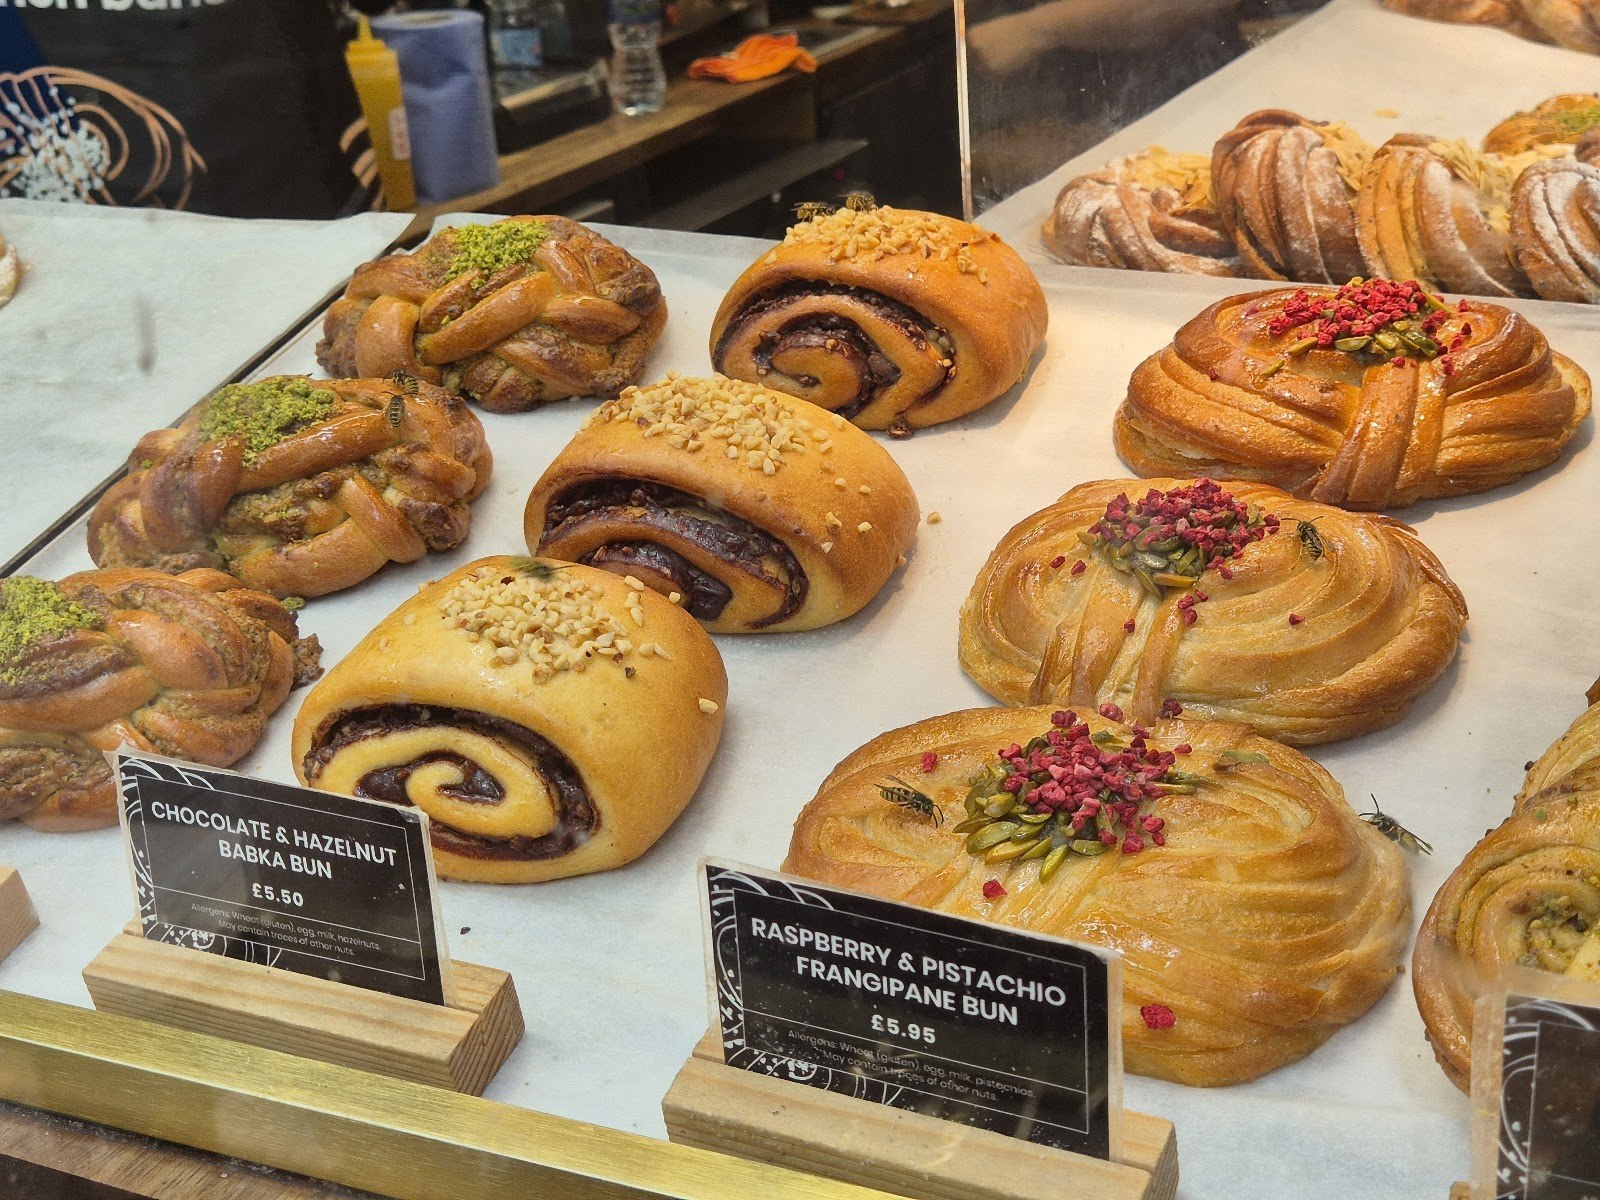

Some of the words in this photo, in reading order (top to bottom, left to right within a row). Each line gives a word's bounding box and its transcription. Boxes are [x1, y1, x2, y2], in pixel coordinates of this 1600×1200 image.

[151, 801, 272, 841] CHOCOLATE
[275, 826, 290, 845] &
[293, 829, 397, 867] HAZELNUT
[218, 839, 287, 870] BABKA
[289, 854, 333, 879] BUN
[251, 882, 304, 907] £5.50
[231, 912, 260, 924] Wheat
[218, 919, 236, 931] May
[237, 924, 270, 937] contain
[270, 931, 299, 944] traces
[299, 936, 308, 945] of
[309, 939, 333, 951] other
[333, 945, 355, 956] nuts.
[751, 917, 892, 966] RASPBERRY
[897, 952, 916, 973] &
[922, 956, 1067, 1007] PISTACHIO
[796, 956, 956, 1011] FRANGIPANE
[962, 995, 1019, 1026] BUN
[788, 1029, 838, 1049] Allergens:
[839, 1042, 874, 1058] Wheat
[870, 1014, 937, 1044] £5.95
[823, 1049, 845, 1066] May
[847, 1056, 888, 1074] contain
[925, 1075, 938, 1086] of
[939, 1079, 970, 1094] other
[970, 1087, 999, 1101] nuts.
